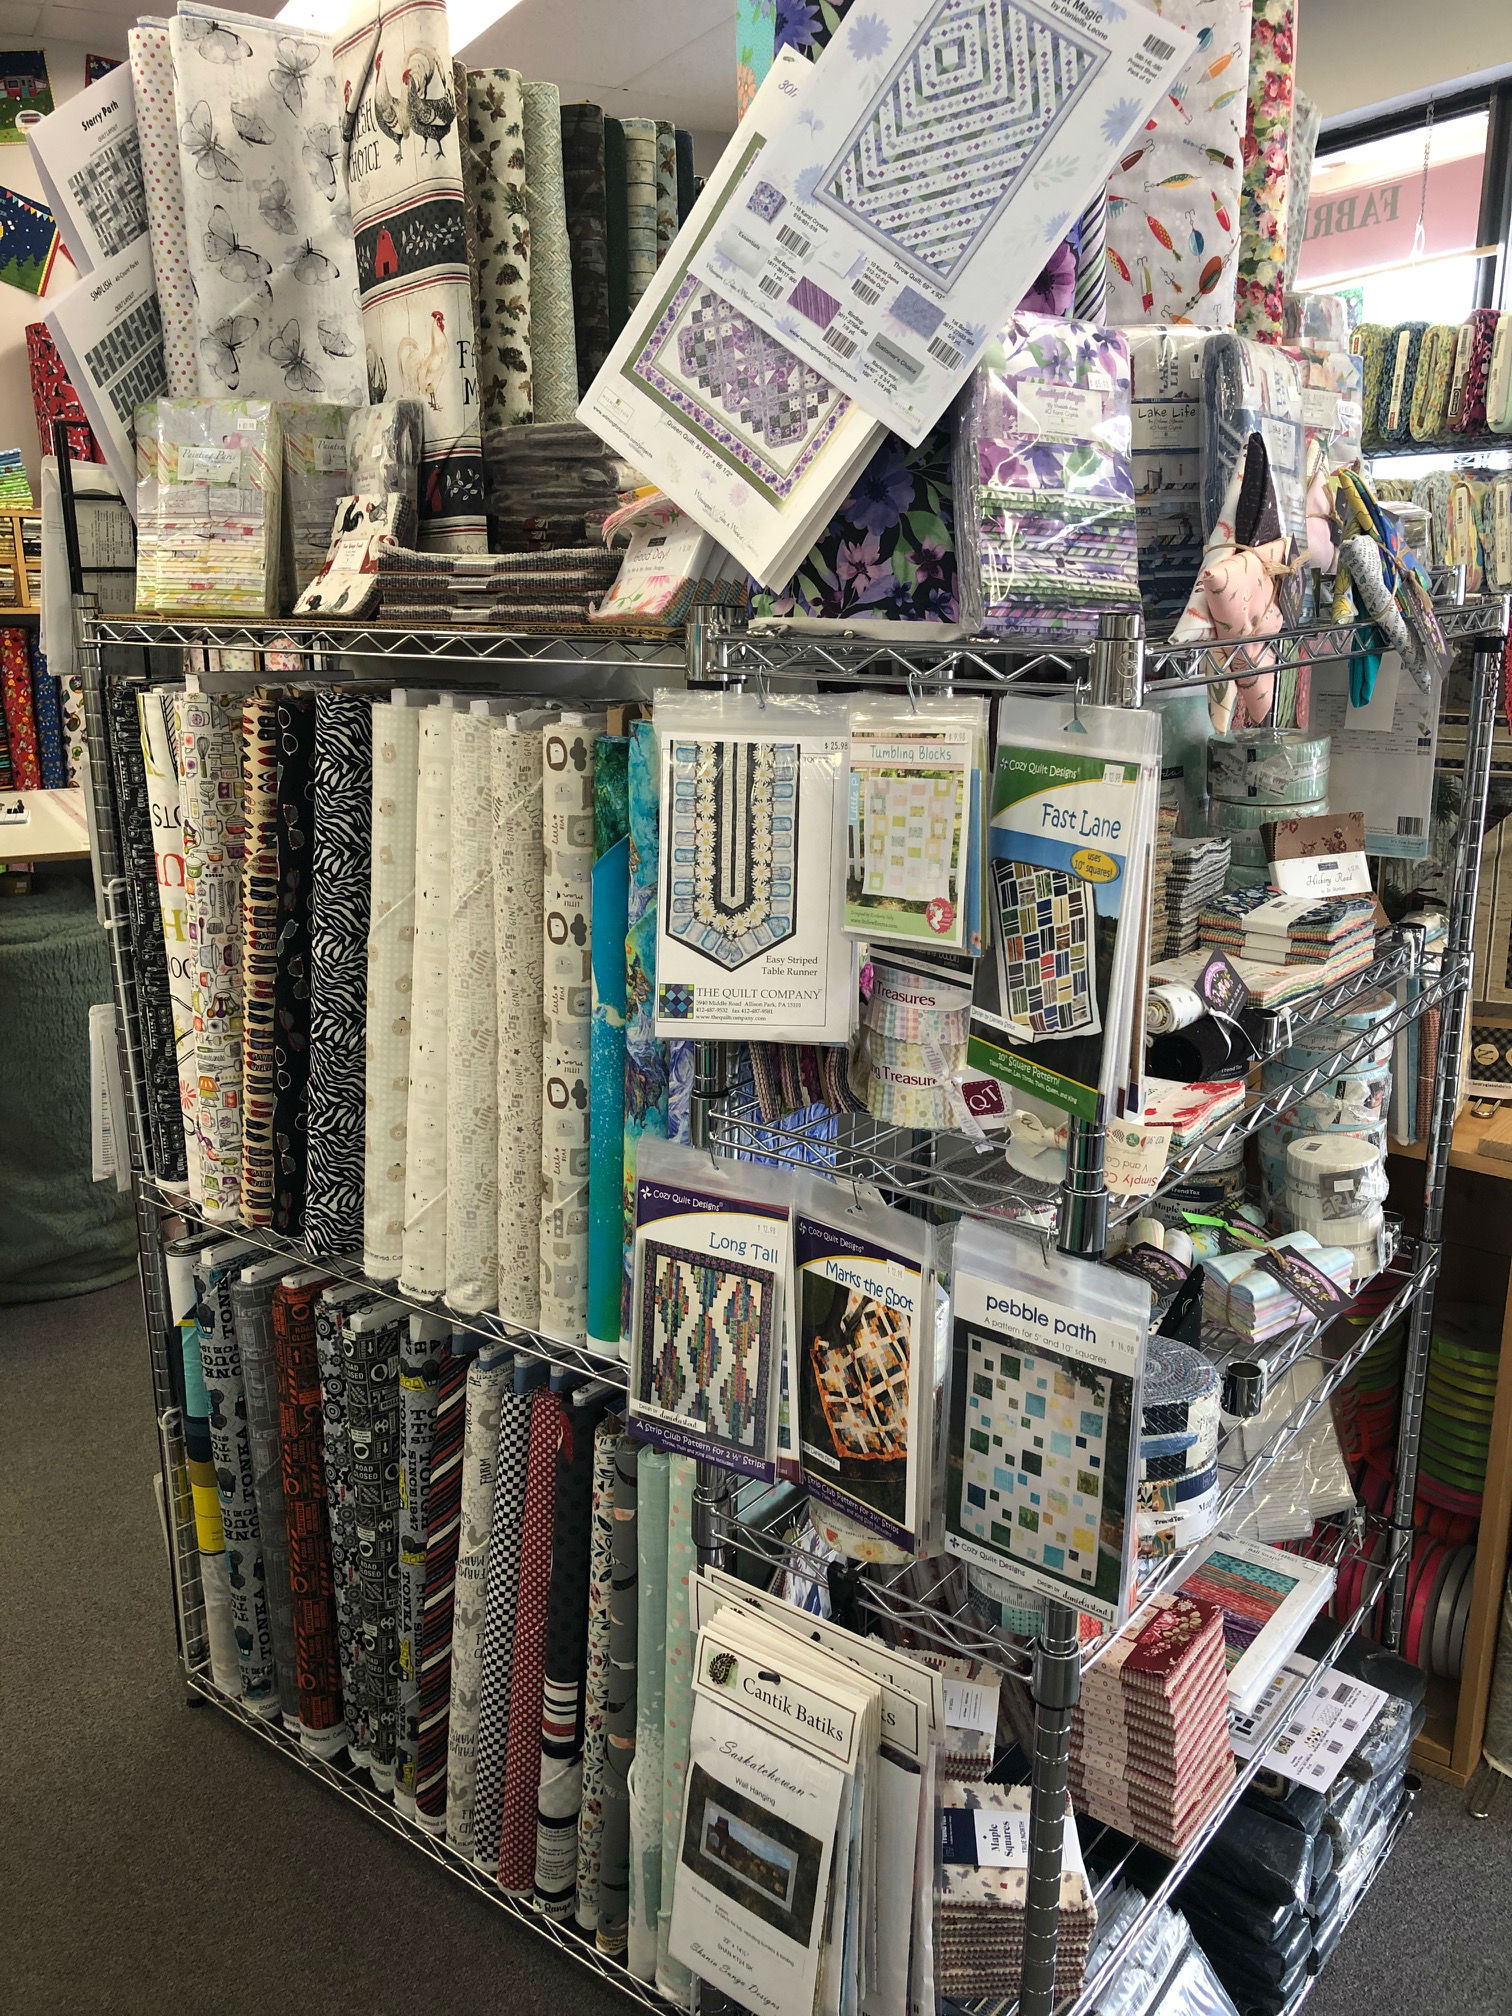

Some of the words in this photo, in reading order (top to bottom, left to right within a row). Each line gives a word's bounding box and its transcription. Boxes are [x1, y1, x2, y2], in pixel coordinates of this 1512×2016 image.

[1050, 1, 1060, 11] by
[1060, 5, 1087, 28] Danielle
[1087, 25, 1109, 41] Leone
[1071, 0, 1103, 24] Magic
[81, 112, 103, 132] Starry
[101, 100, 119, 117] Path
[800, 209, 814, 221] Karat
[811, 218, 830, 234] Crystals
[737, 230, 762, 251] Essentials
[892, 261, 910, 276] Throw
[907, 271, 924, 286] Quilt:
[90, 278, 113, 302] SIMPLISH
[873, 340, 901, 363] Customer's
[898, 358, 918, 376] Choice
[1138, 406, 1167, 418] Lake
[1172, 405, 1196, 417] Life
[666, 419, 684, 439] Queen
[831, 741, 848, 750] 25.98
[870, 745, 915, 761] Tumbling
[918, 745, 952, 761] Blocks
[1008, 759, 1028, 771] Cozy
[1028, 761, 1048, 775] Quilt
[1049, 765, 1078, 780] Designs
[1042, 803, 1077, 829] Fast
[1079, 809, 1122, 840] Lane
[1074, 859, 1085, 870] 10"
[1086, 865, 1113, 878] squares!
[1087, 852, 1101, 863] uses
[1306, 873, 1332, 886] Hickory
[1334, 872, 1353, 883] Road
[761, 967, 785, 976] Table
[787, 968, 818, 976] Runner
[766, 955, 785, 966] Easy
[787, 956, 818, 966] Striped
[696, 988, 719, 997] THE
[722, 988, 758, 1000] QUILT
[878, 981, 936, 1006] Treasures
[998, 1052, 1008, 1061] 10"
[1008, 1056, 1032, 1074] Square
[1032, 1066, 1061, 1087] Pattern!
[969, 1084, 1000, 1112] QT
[1046, 1084, 1060, 1097] Queen,
[1059, 1091, 1068, 1099] and
[1122, 1159, 1142, 1172] and
[1122, 1173, 1158, 1188] Simply
[653, 1189, 671, 1200] Cozy
[672, 1193, 691, 1205] Quilt
[692, 1198, 720, 1212] Designs
[708, 1231, 747, 1256] Long
[751, 1243, 778, 1264] Tall
[808, 1226, 823, 1238] Cozy
[823, 1231, 839, 1244] Quilt
[840, 1237, 862, 1253] Designs
[826, 1260, 862, 1288] Marks
[863, 1279, 884, 1297] the
[885, 1286, 914, 1312] Spot
[986, 1295, 1049, 1327] pebble
[1054, 1317, 1096, 1344] path
[984, 1316, 990, 1324] A
[992, 1318, 1020, 1335] pattern
[1021, 1327, 1033, 1339] for
[1043, 1337, 1060, 1349] and
[1061, 1342, 1074, 1352] 10"
[1075, 1349, 1108, 1365] squares
[639, 1402, 652, 1412] Design
[636, 1421, 644, 1429] A
[644, 1423, 663, 1436] Strip
[664, 1429, 682, 1443] Club
[682, 1436, 711, 1452] Pattern
[712, 1446, 725, 1456] for
[742, 1456, 766, 1470] Strips
[695, 1450, 705, 1458] King
[354, 1464, 374, 1473] ROAD
[408, 1450, 418, 1498] SINCE
[480, 1457, 490, 1486] FARM
[807, 1475, 821, 1490] Strip
[821, 1484, 836, 1497] Club
[836, 1491, 859, 1510] Pattern
[859, 1505, 869, 1515] for
[881, 1518, 899, 1535] Strips
[846, 1507, 854, 1515] and
[961, 1543, 979, 1556] Cozy
[979, 1551, 998, 1565] Quilt
[998, 1559, 1026, 1577] Designs
[1037, 1578, 1054, 1591] Design
[400, 1571, 412, 1634] TONKA
[254, 1586, 273, 1660] TONKA
[743, 1677, 793, 1717] Cantik
[795, 1703, 844, 1743] Batiks
[719, 1740, 806, 1797] Saskatchewan
[735, 1776, 749, 1791] Wall
[749, 1783, 776, 1807] Hanging
[989, 1822, 1000, 1852] Maple
[1004, 1820, 1013, 1858] Squares
[544, 1902, 571, 1914] Range
[746, 1982, 784, 2013] Designs
